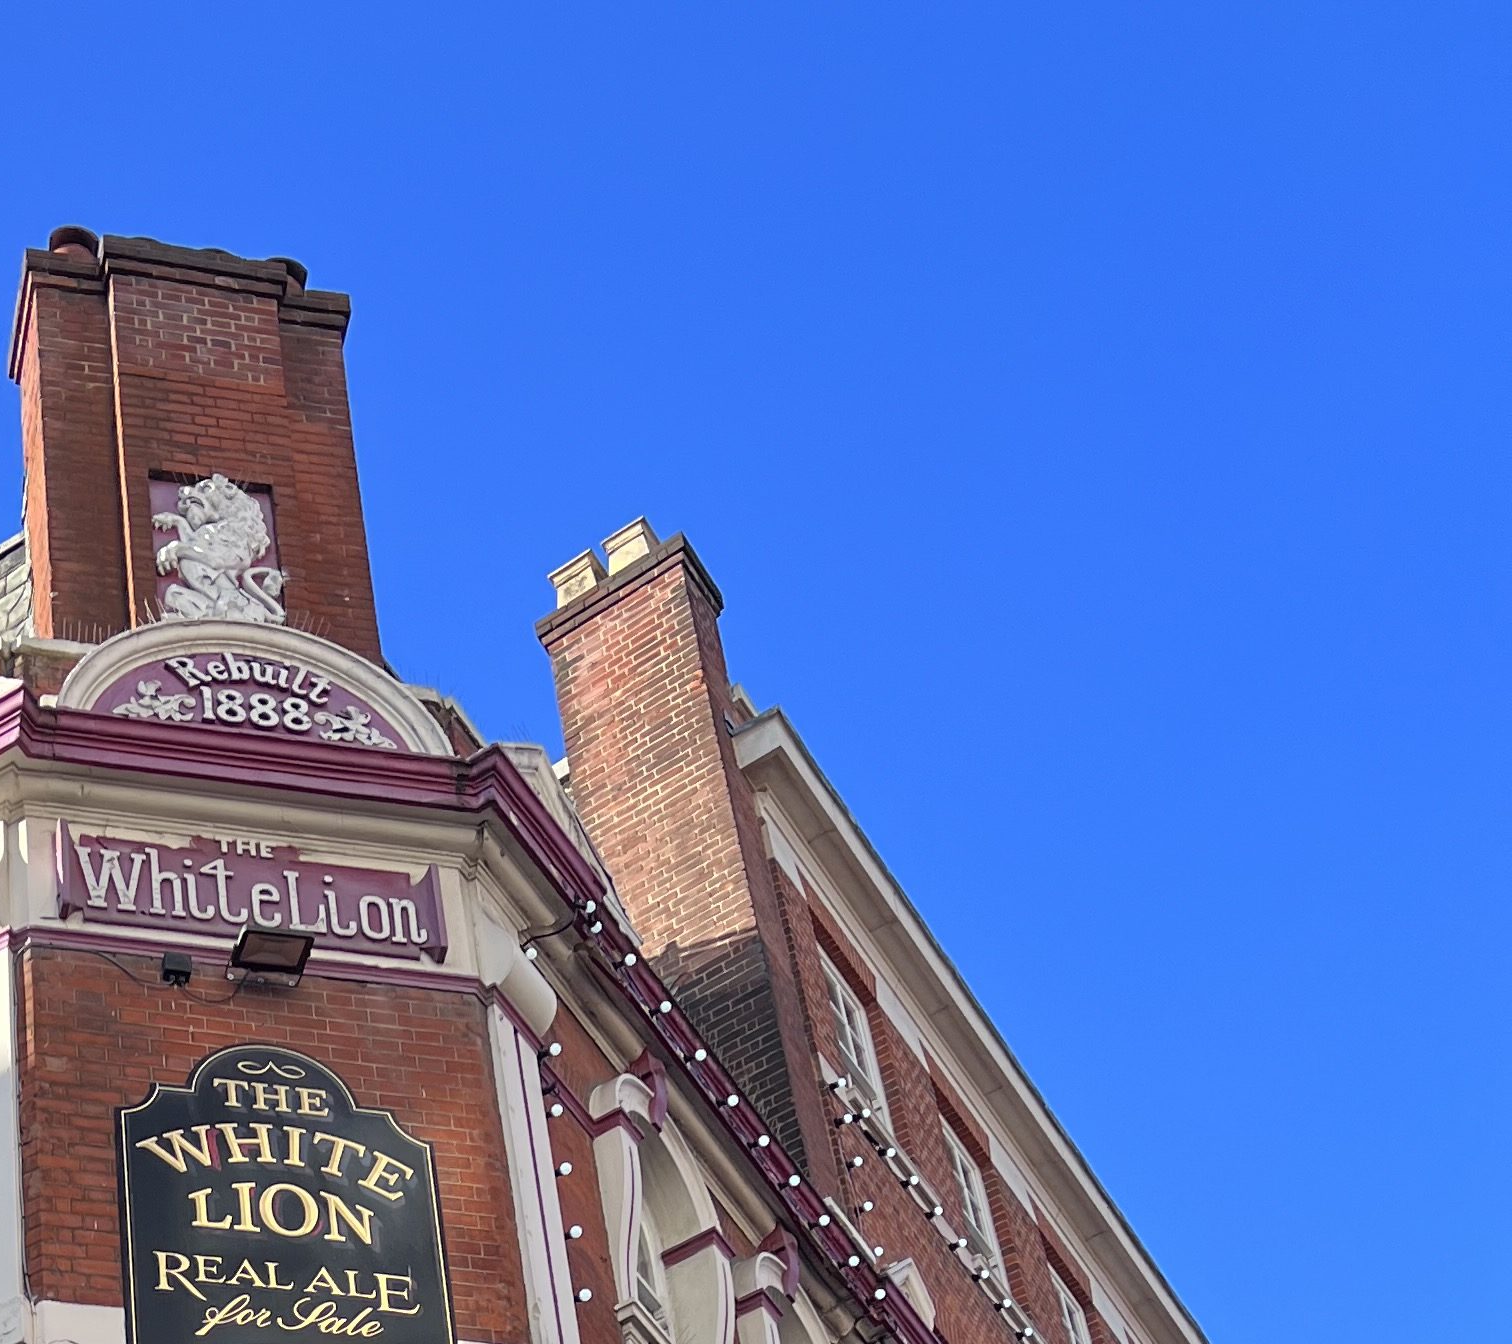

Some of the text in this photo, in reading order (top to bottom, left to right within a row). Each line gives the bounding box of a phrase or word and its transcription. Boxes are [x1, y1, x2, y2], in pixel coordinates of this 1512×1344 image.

[165, 651, 331, 705] Rebuilt
[200, 685, 313, 733] 1888
[215, 838, 275, 859] THE
[213, 1077, 329, 1118] THE
[135, 1122, 414, 1202] WHITE
[188, 1181, 375, 1246] LION
[152, 1249, 420, 1315] REAL ALE
[194, 1294, 385, 1338] for Sale
